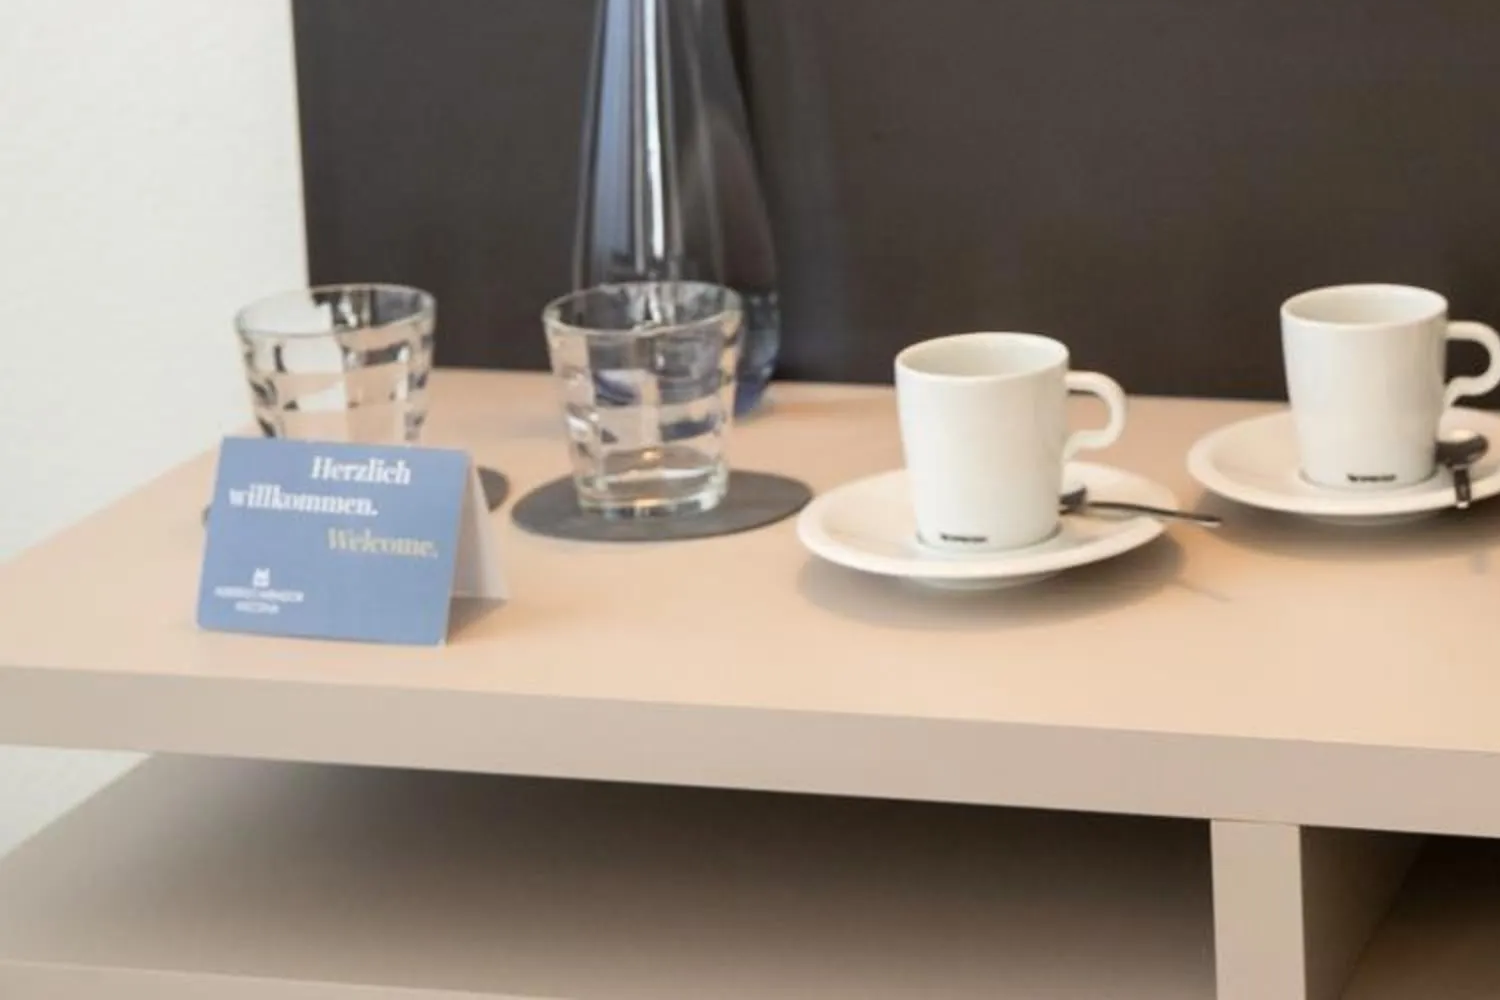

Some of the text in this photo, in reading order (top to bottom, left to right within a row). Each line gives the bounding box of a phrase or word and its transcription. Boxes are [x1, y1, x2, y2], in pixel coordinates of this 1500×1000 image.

[311, 456, 411, 485] Herzlich
[229, 483, 379, 516] willkommen.
[327, 528, 439, 559] Welcome.
